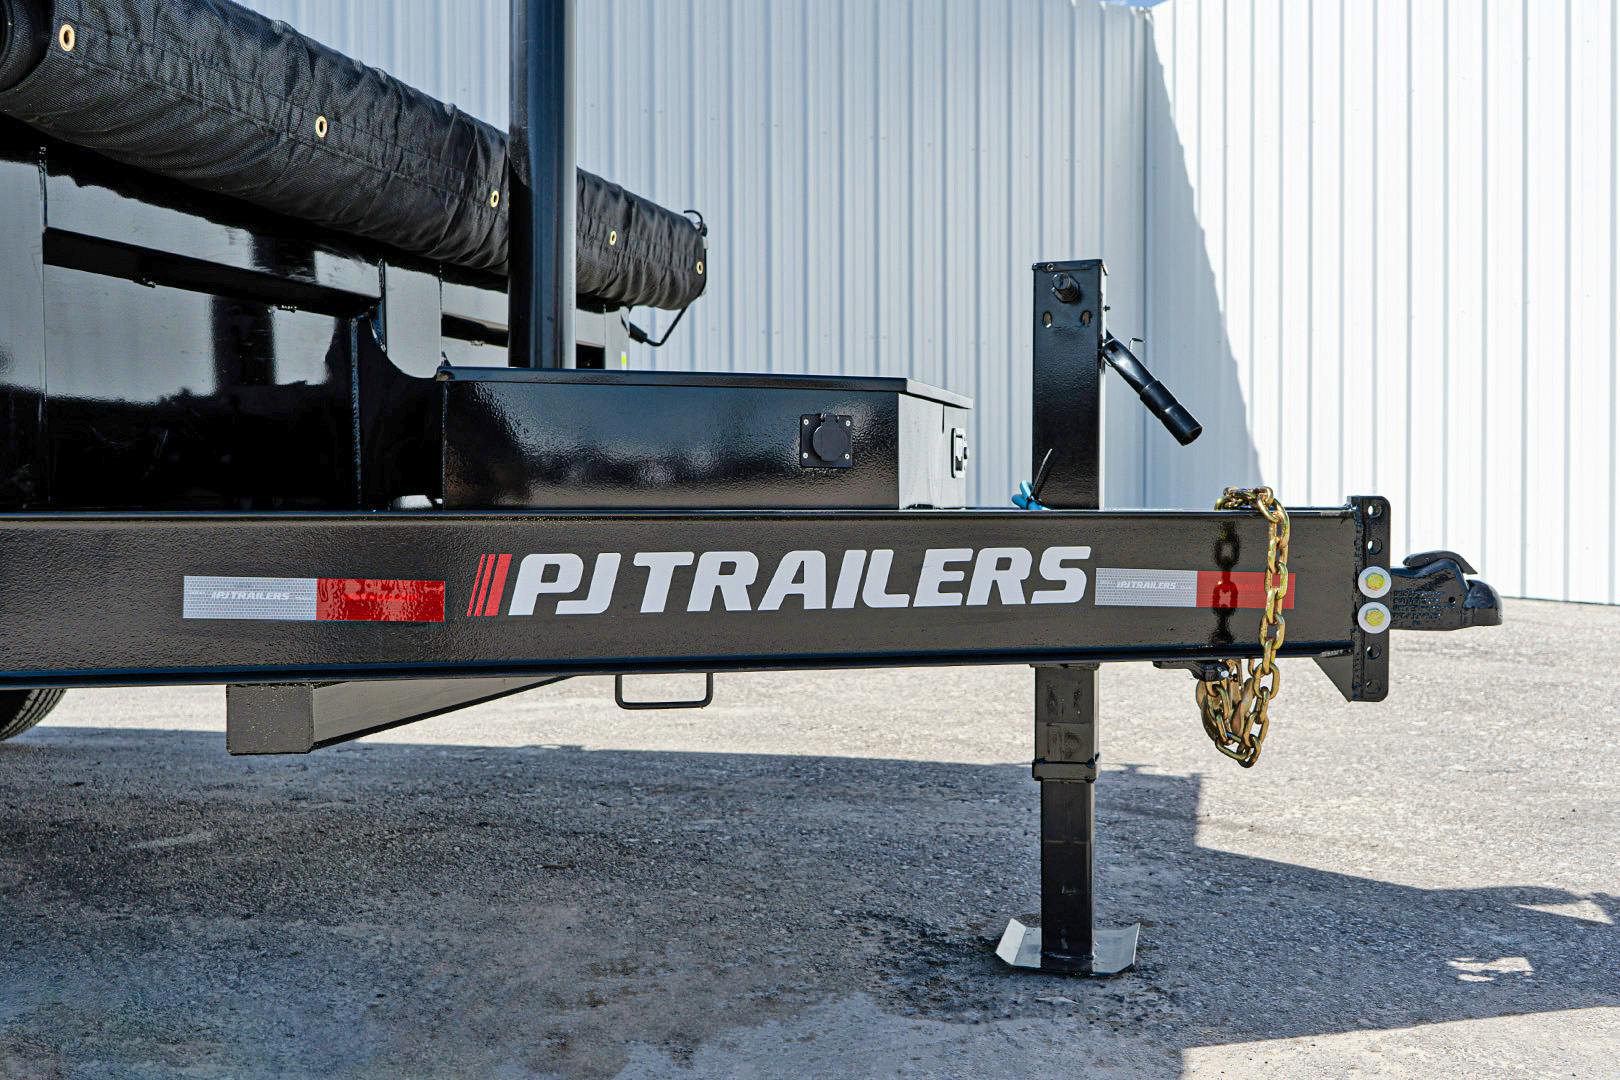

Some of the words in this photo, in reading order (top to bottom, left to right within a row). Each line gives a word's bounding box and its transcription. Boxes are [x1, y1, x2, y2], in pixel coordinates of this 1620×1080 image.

[508, 553, 621, 615] PJ
[633, 546, 1092, 612] TRAILERS
[1131, 581, 1176, 590] TRAILERS
[230, 591, 290, 600] TRAILERS
